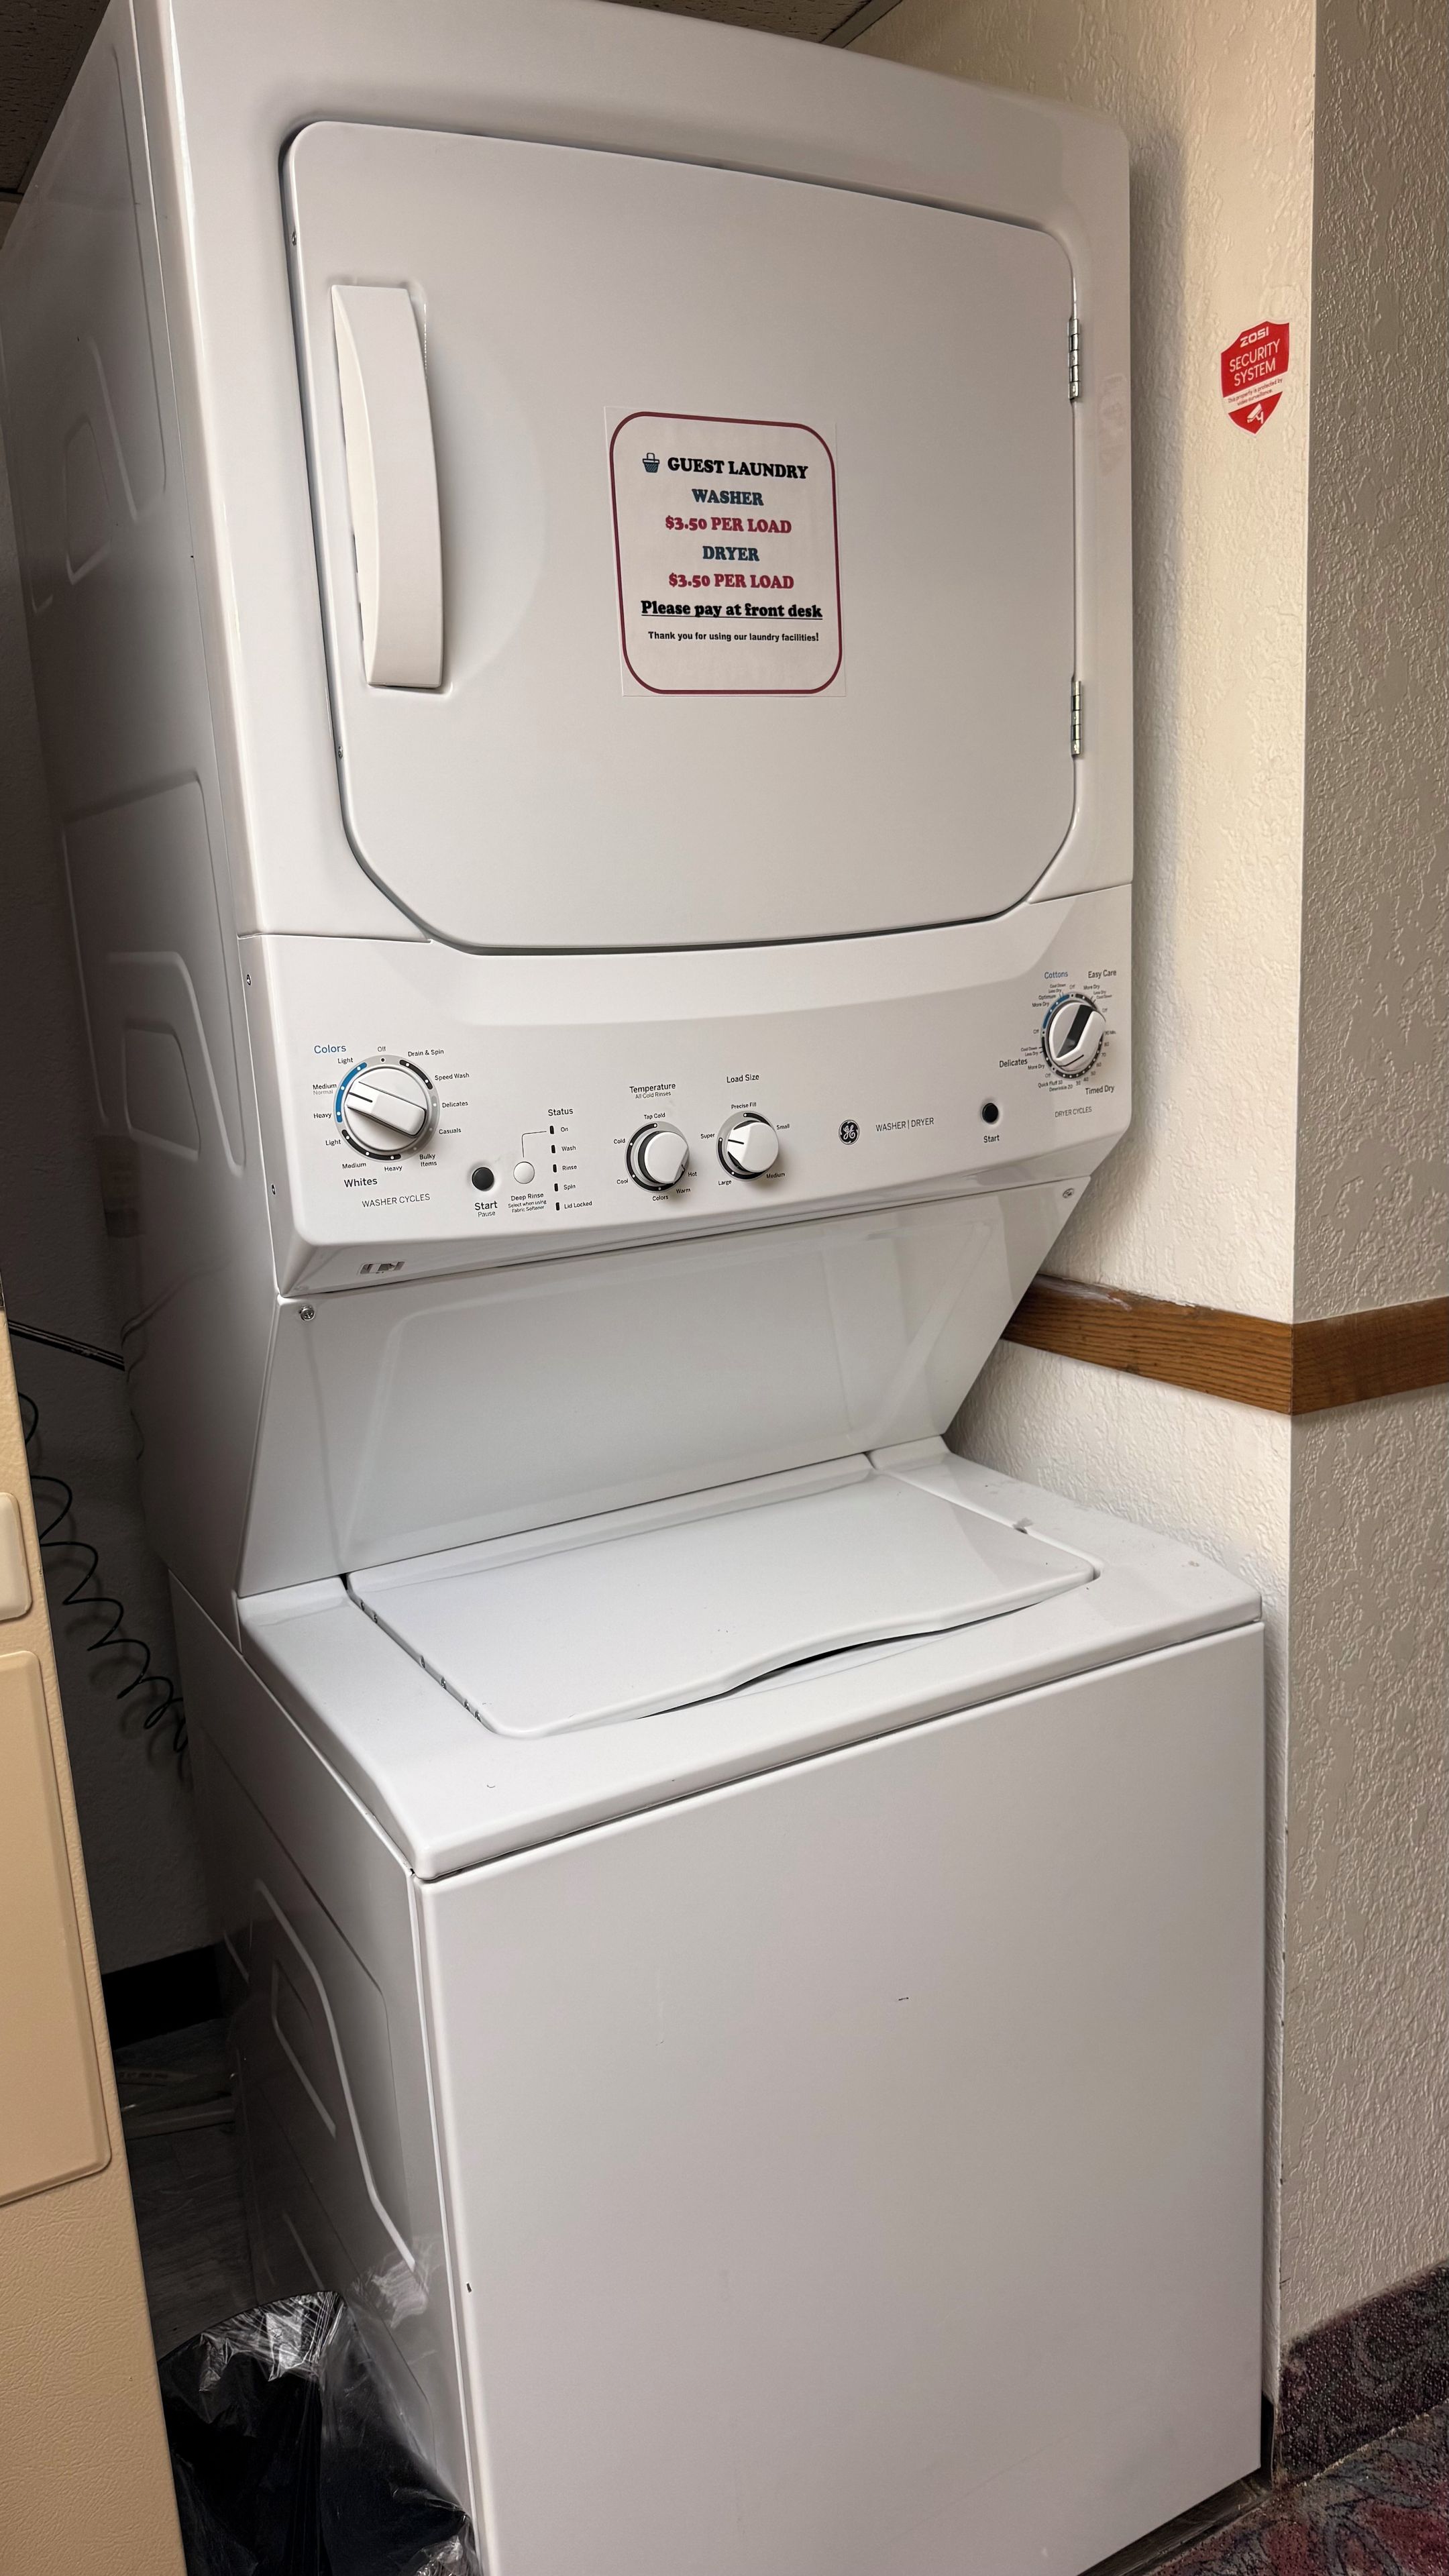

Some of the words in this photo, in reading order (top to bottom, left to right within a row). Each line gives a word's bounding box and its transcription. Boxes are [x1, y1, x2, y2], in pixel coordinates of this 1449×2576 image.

[1240, 327, 1269, 347] ZOSI
[1230, 339, 1280, 372] SECURITY
[1234, 358, 1275, 386] SYSTEM
[667, 458, 724, 473] GUEST
[729, 462, 808, 479] LAUNDRY
[692, 489, 763, 506] WASHER
[665, 516, 707, 531] $3.50
[711, 517, 744, 531] PER
[748, 519, 792, 533] LOAD
[703, 546, 759, 561] DRYER
[669, 573, 710, 588] $3.50
[714, 574, 747, 588] PER
[751, 575, 794, 589] LOAD
[641, 601, 691, 614] Please
[694, 606, 722, 617] pay
[726, 604, 742, 616] at
[745, 603, 785, 617] front
[788, 604, 822, 618] desk
[648, 631, 676, 640] Thank
[678, 633, 693, 641] you
[695, 632, 706, 640] for
[709, 633, 731, 642] using
[749, 633, 780, 642] laundry
[782, 633, 819, 641] facilities!
[314, 1044, 346, 1054] Colors
[1000, 1059, 1028, 1067] Delicates
[435, 1073, 453, 1081] Speed
[727, 1075, 743, 1083] Load
[629, 1082, 676, 1093] Temperature
[1085, 1086, 1104, 1095] Timed
[731, 1102, 749, 1110] Precise
[548, 1108, 574, 1116] Status
[1055, 1108, 1072, 1118] DRYER
[1073, 1106, 1092, 1116] CYCLES
[876, 1120, 906, 1132] WASHER
[911, 1117, 934, 1128] DRYER
[983, 1134, 1000, 1143] Start
[344, 1177, 378, 1187] Whites
[362, 1197, 397, 1208] WASHER
[399, 1193, 430, 1203] CYCLES
[475, 1200, 498, 1210] Start
